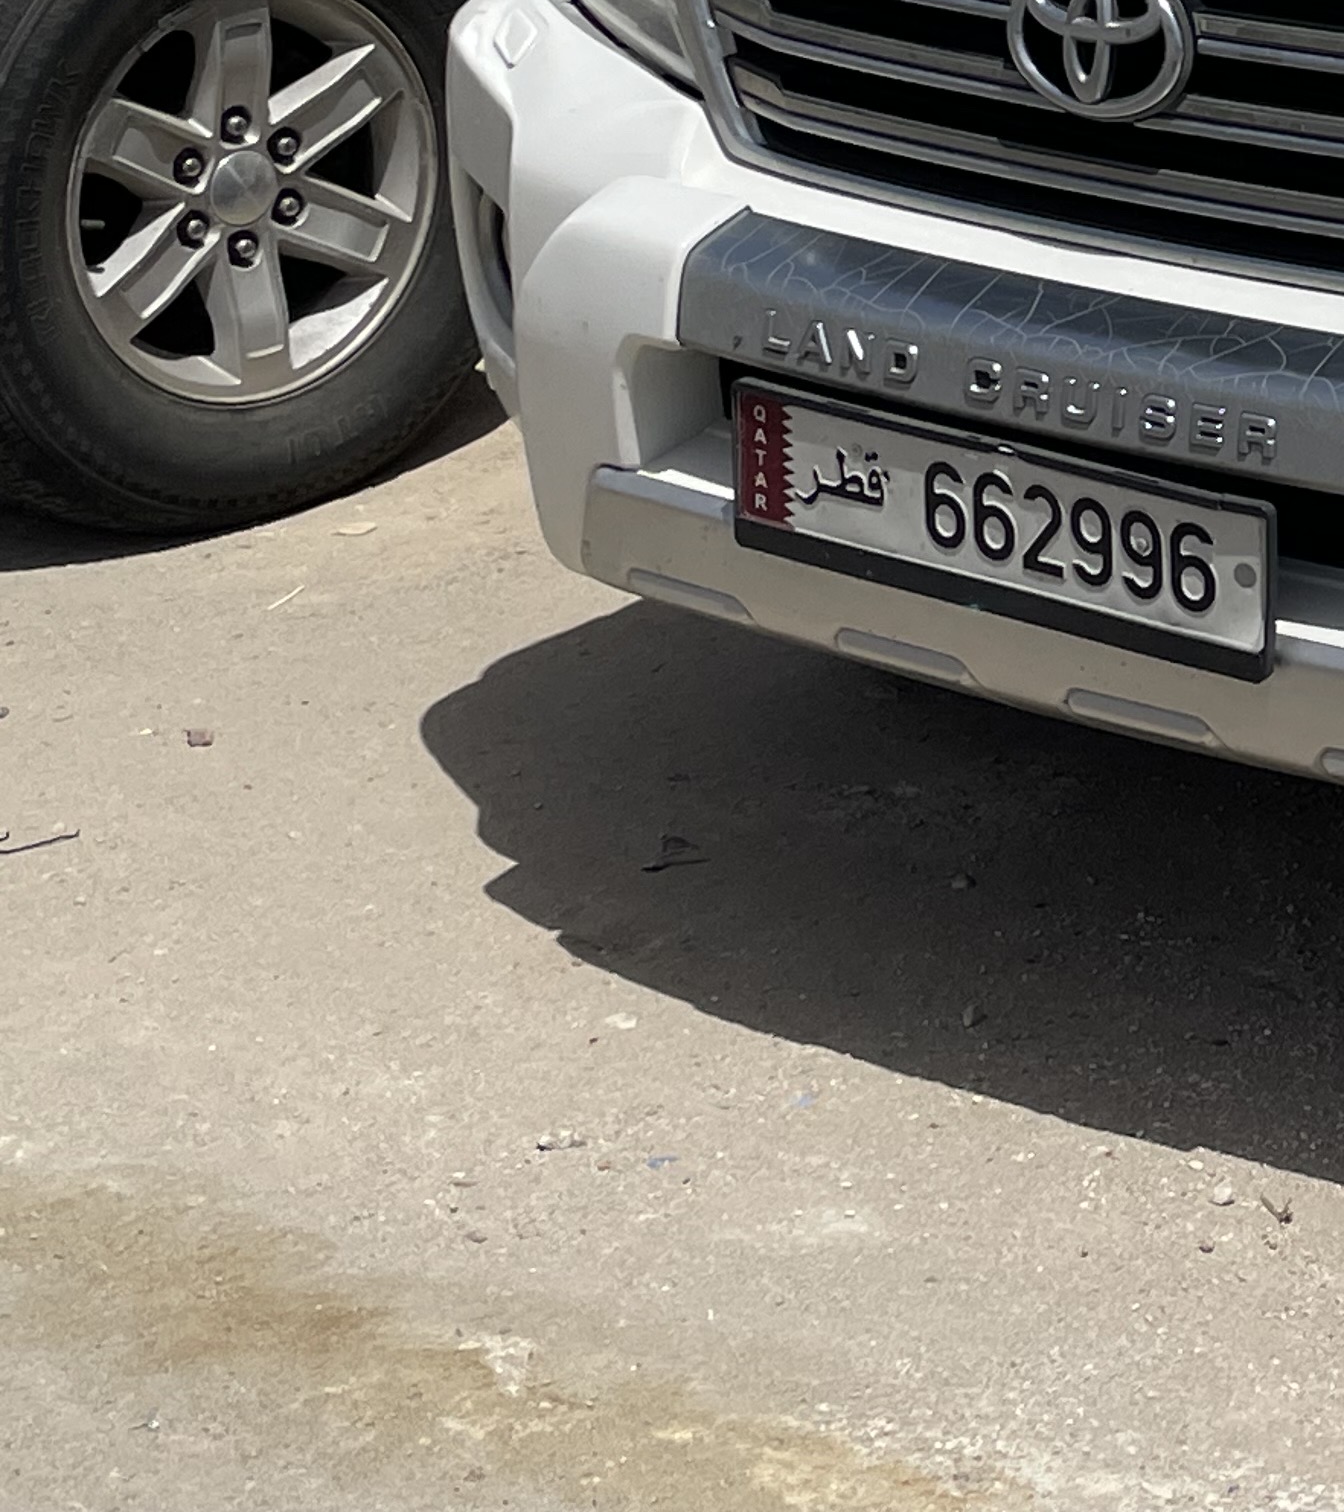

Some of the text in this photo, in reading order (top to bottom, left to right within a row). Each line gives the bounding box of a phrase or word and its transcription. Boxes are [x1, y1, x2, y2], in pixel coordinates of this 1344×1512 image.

[760, 309, 1278, 460] LAND CRUISER
[752, 404, 769, 512] QATAR
[795, 446, 890, 506] قطر
[925, 461, 1217, 613] 662996
